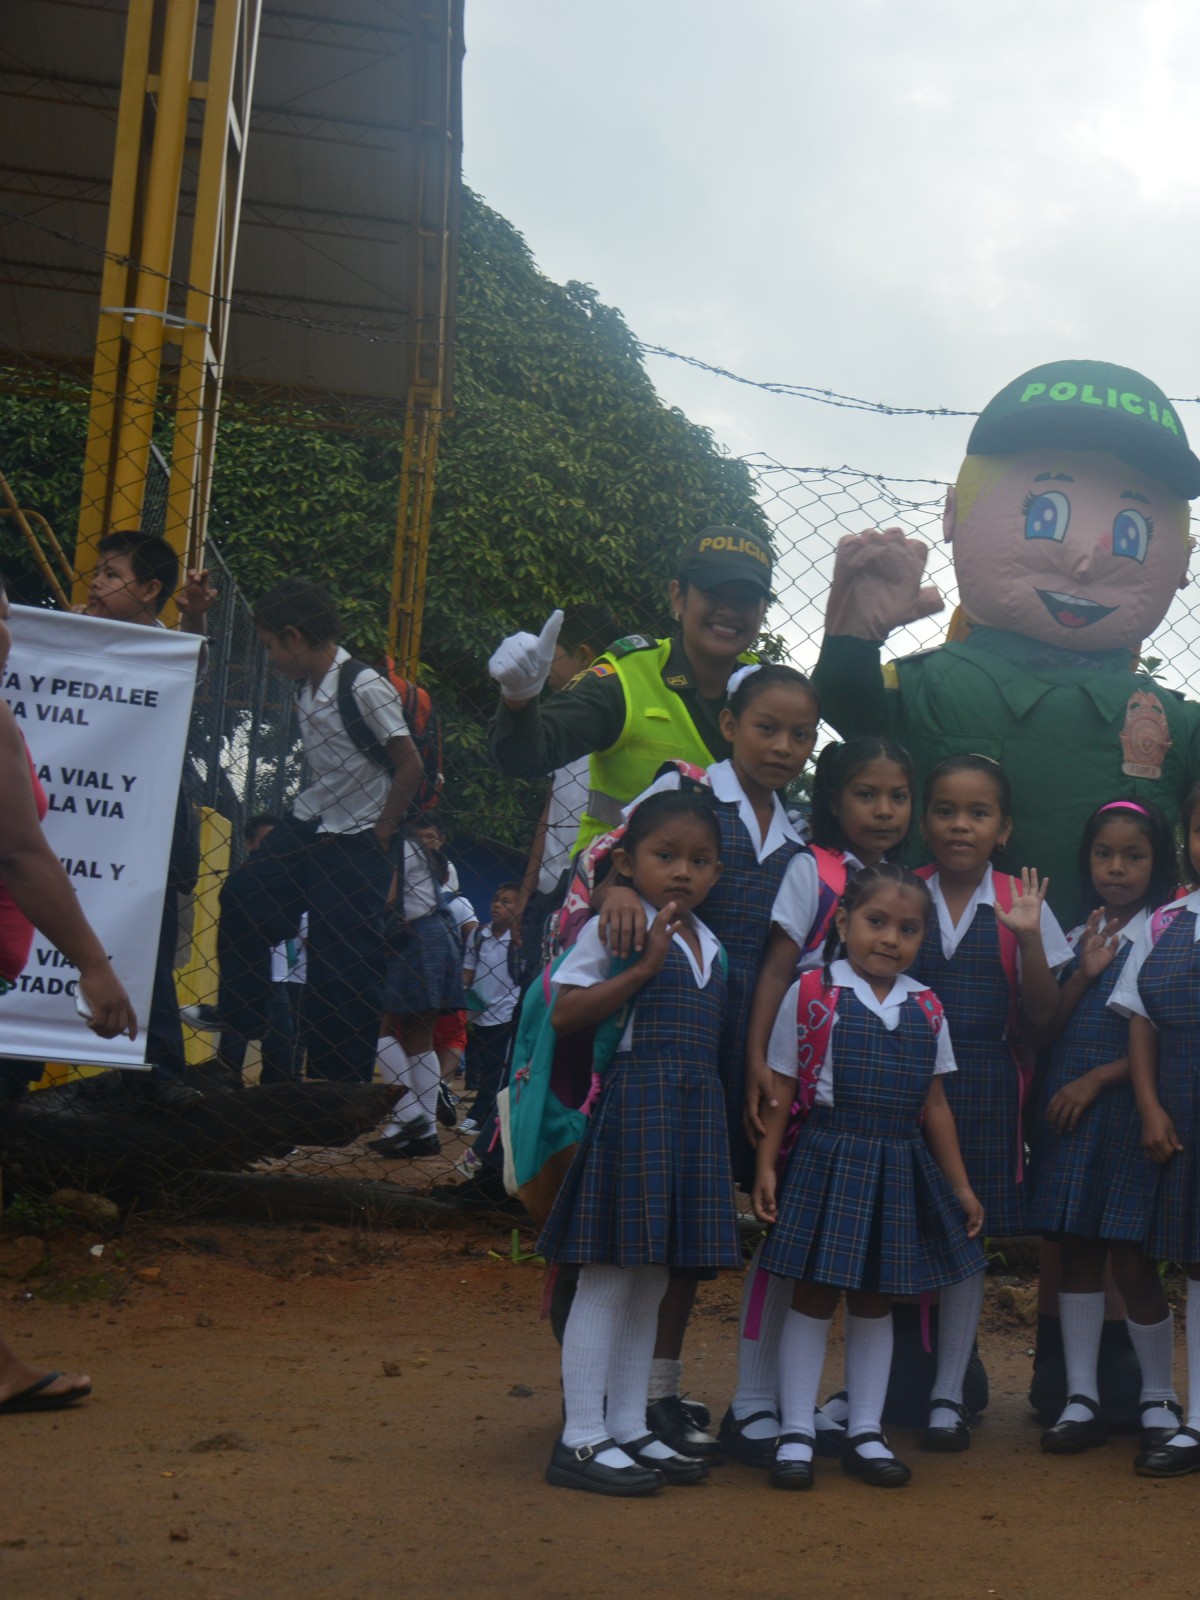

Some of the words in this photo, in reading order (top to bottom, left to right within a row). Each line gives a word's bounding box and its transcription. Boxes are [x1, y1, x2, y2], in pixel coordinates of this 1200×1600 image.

[1019, 381, 1179, 436] POLICIA
[698, 536, 769, 565] POLICIA
[30, 674, 46, 693] Y
[51, 678, 159, 708] PEDALEE
[36, 703, 90, 726] VIAL
[61, 766, 114, 791] VIAL
[121, 774, 138, 793] Y
[85, 797, 125, 819] VIA
[60, 857, 103, 880] IAL
[110, 862, 126, 881] Y
[36, 948, 75, 968] VIA
